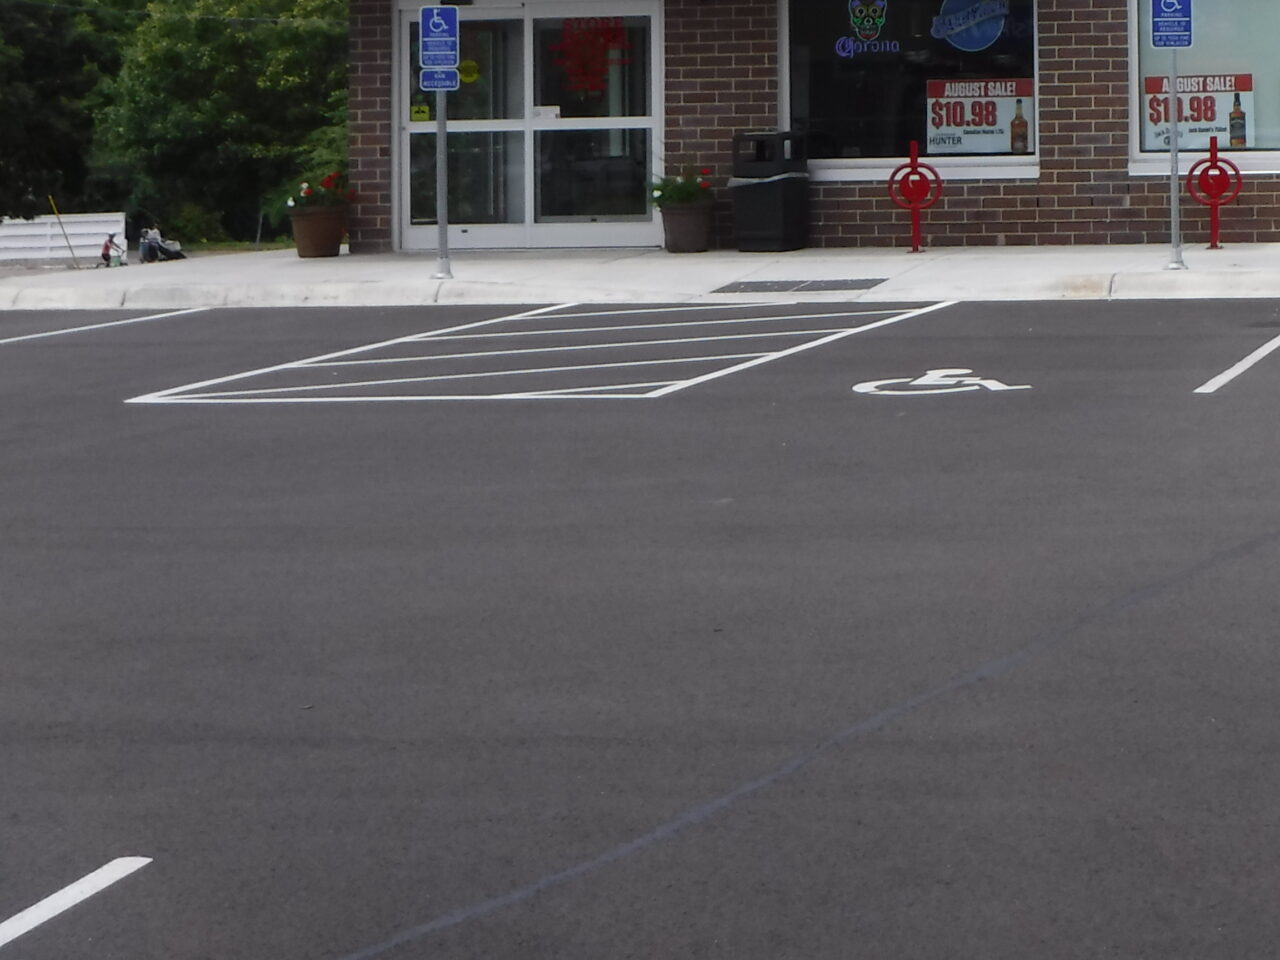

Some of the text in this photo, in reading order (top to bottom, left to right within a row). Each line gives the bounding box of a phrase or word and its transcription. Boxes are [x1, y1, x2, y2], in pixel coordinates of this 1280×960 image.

[835, 36, 900, 58] Corona
[944, 81, 1017, 97] AUGUST SALE!
[1162, 76, 1236, 93] AGUST SALE!
[931, 99, 998, 130] $10.98
[929, 136, 963, 146] HUNTER
